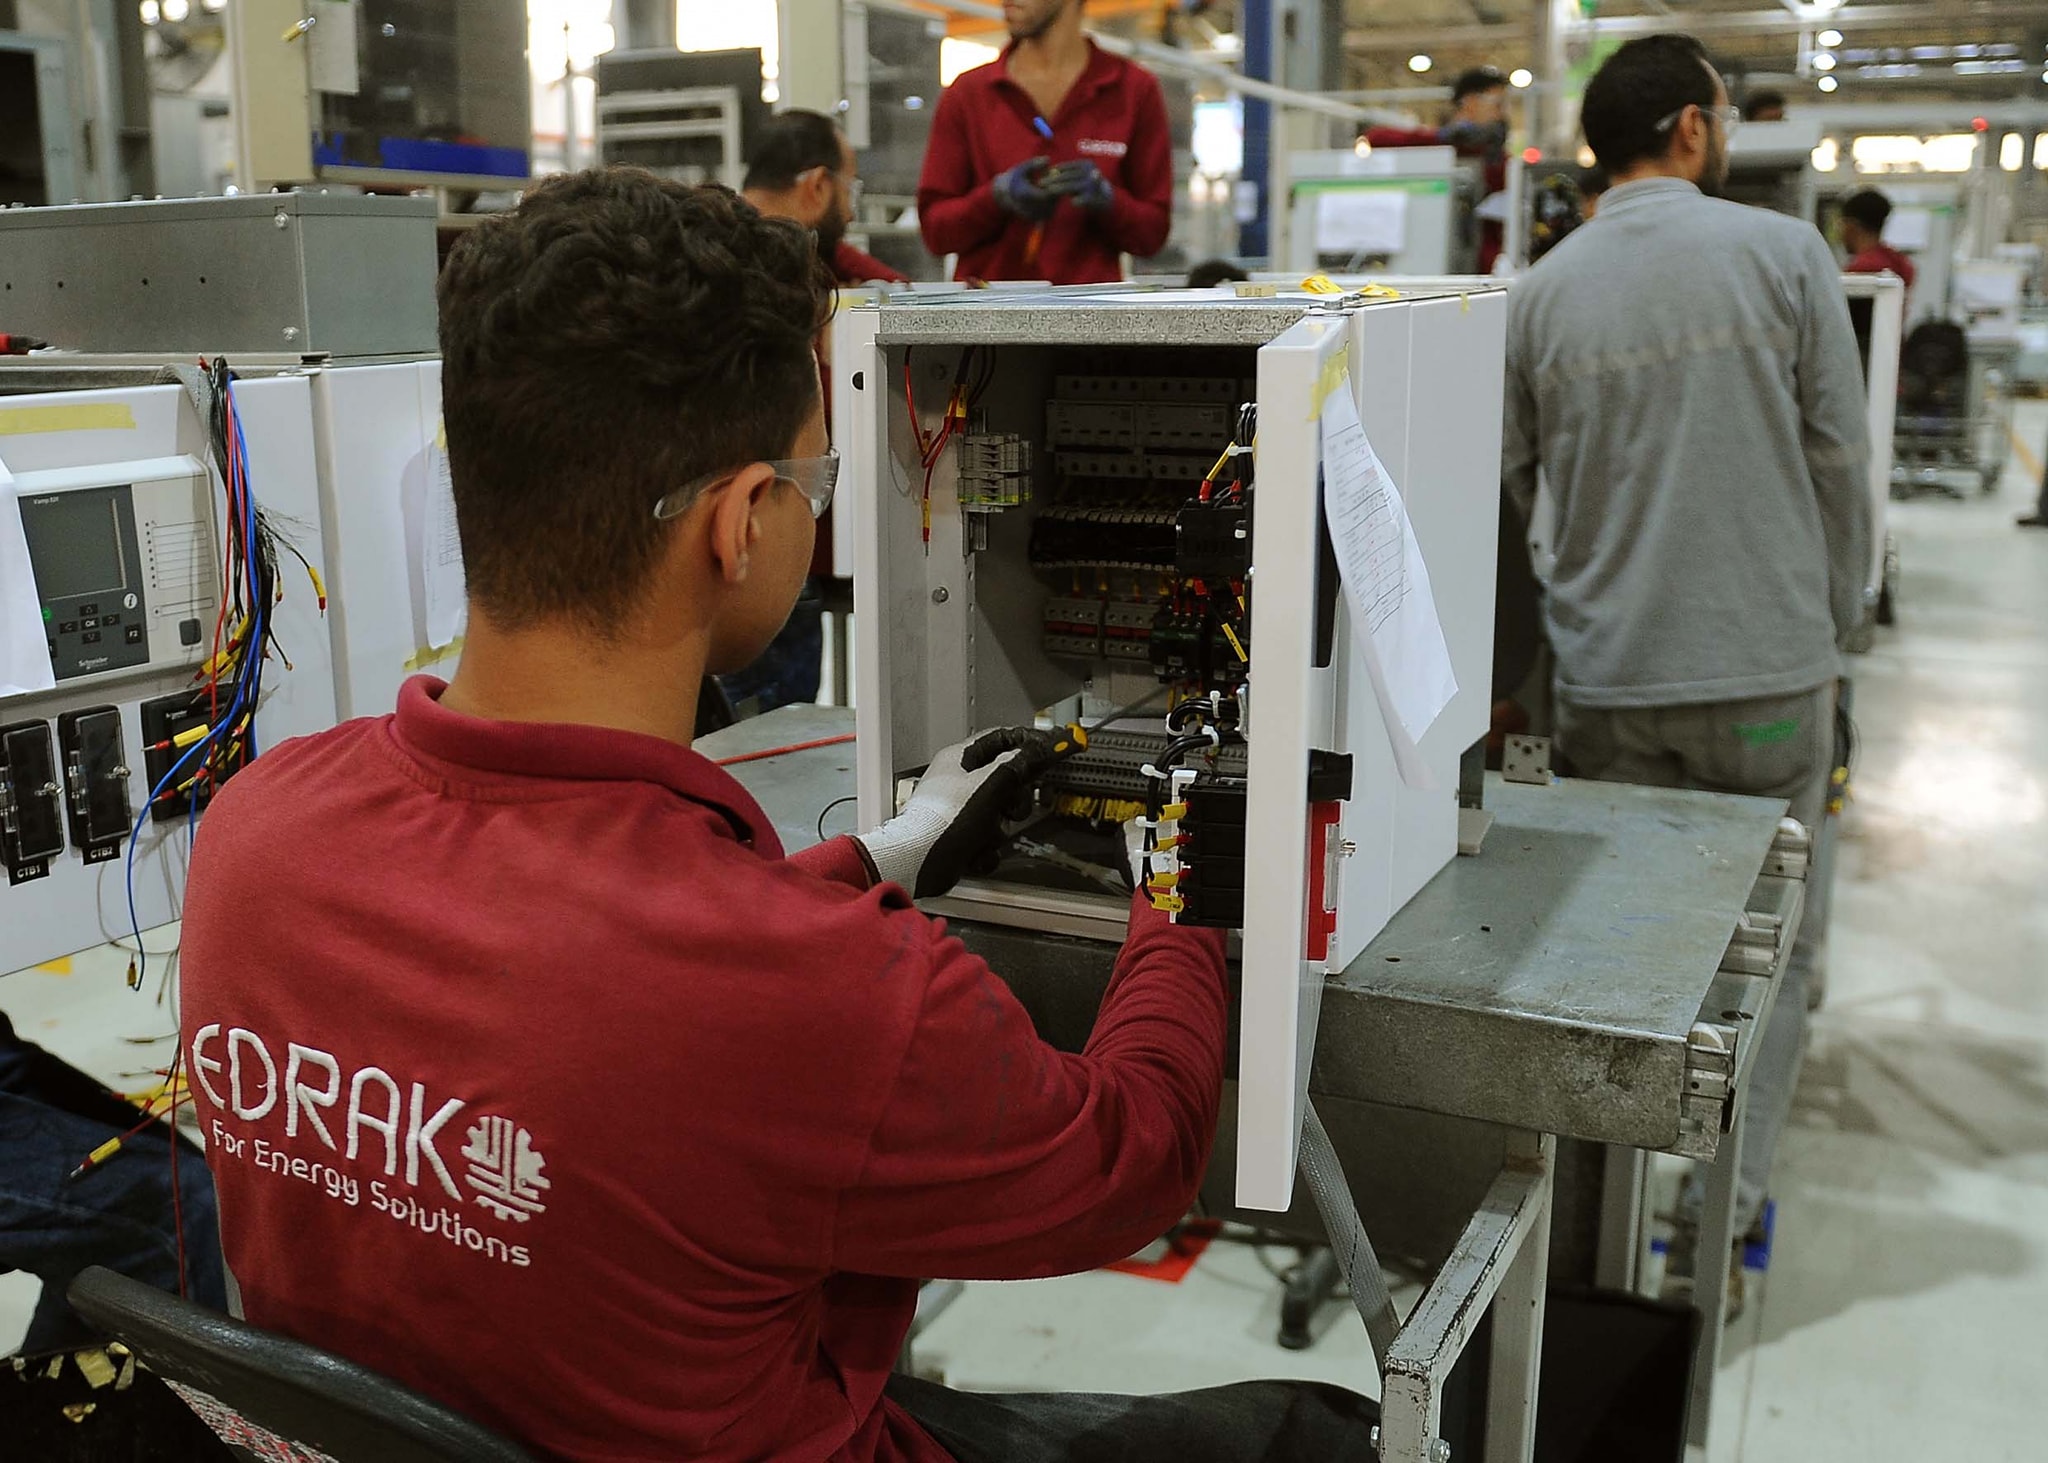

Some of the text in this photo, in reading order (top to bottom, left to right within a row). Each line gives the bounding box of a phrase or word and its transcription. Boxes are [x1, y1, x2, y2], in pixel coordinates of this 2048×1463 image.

[85, 619, 96, 628] OK
[129, 630, 138, 638] F2
[90, 846, 113, 859] CTB2
[17, 865, 41, 879] CTB1
[192, 1024, 467, 1202] EDRAK
[212, 1118, 531, 1267] For Energy Solutions
